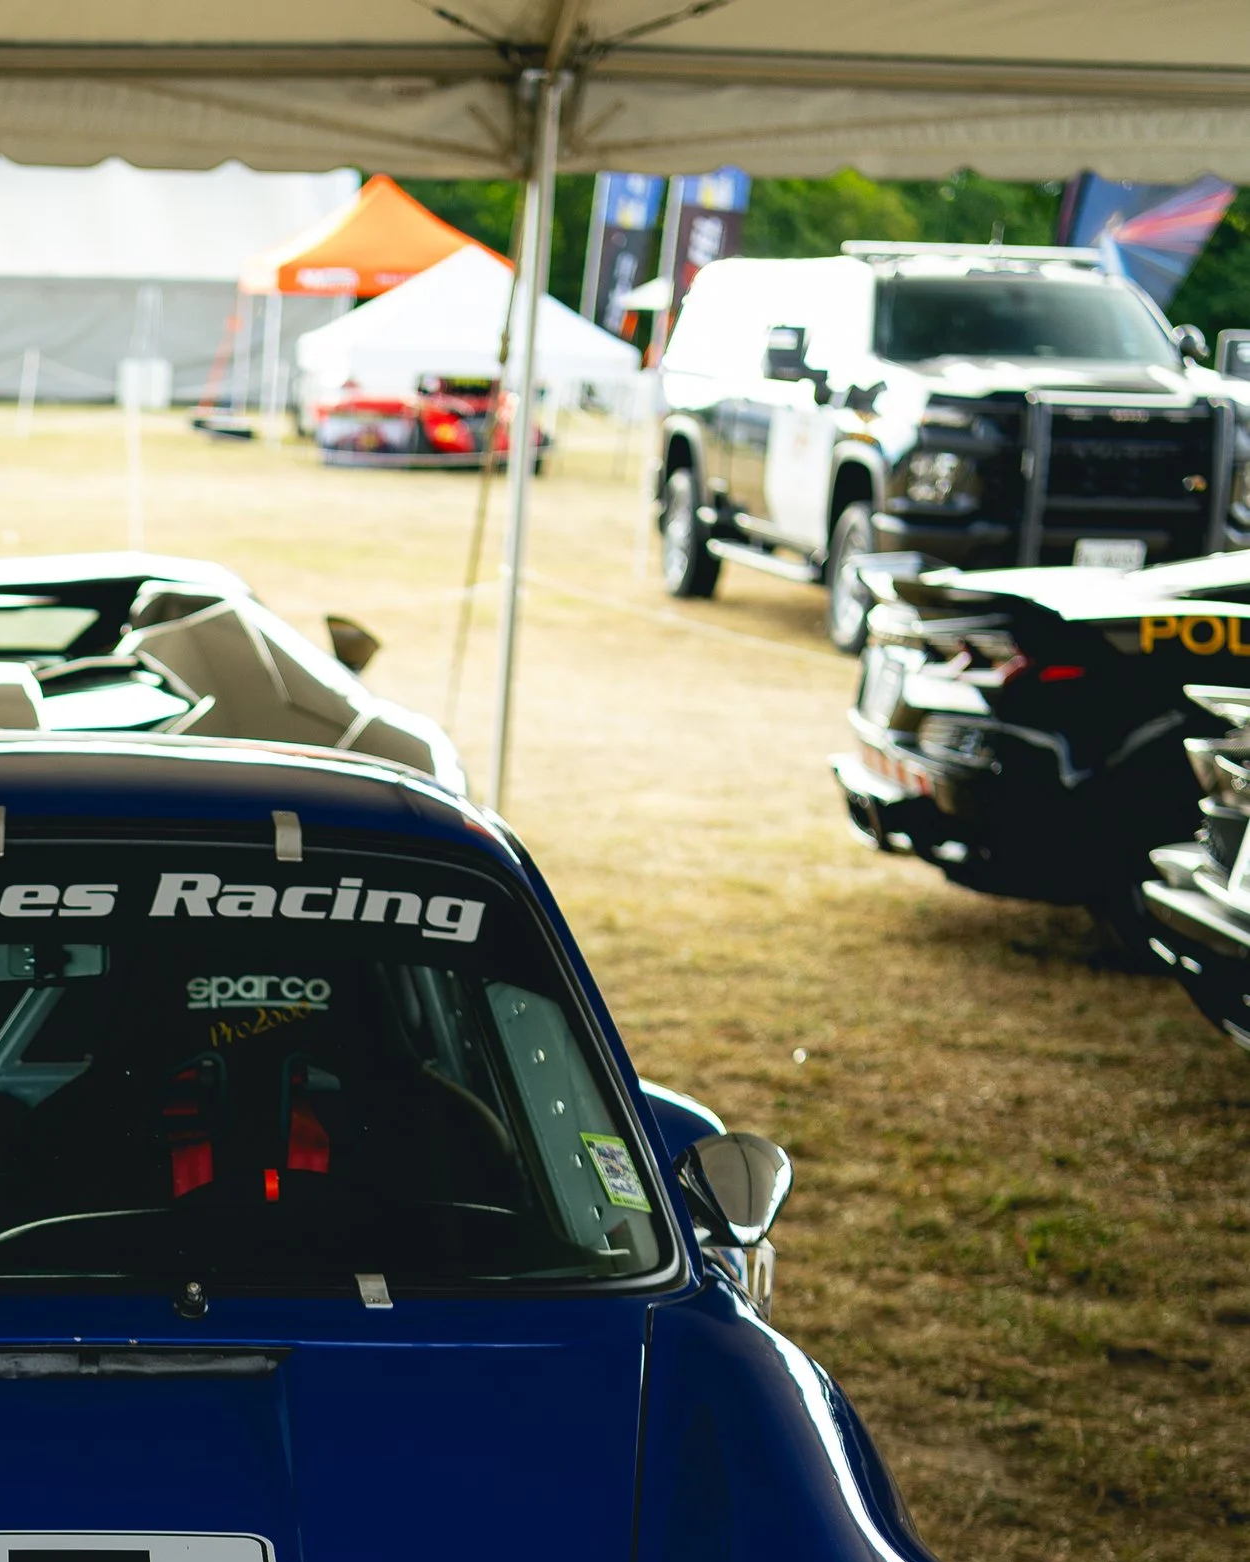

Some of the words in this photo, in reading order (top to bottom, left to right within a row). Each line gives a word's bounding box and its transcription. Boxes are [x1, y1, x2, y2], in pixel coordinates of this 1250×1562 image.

[1140, 616, 1250, 656] POL
[149, 872, 486, 944] Racing
[186, 973, 332, 1010] sparco
